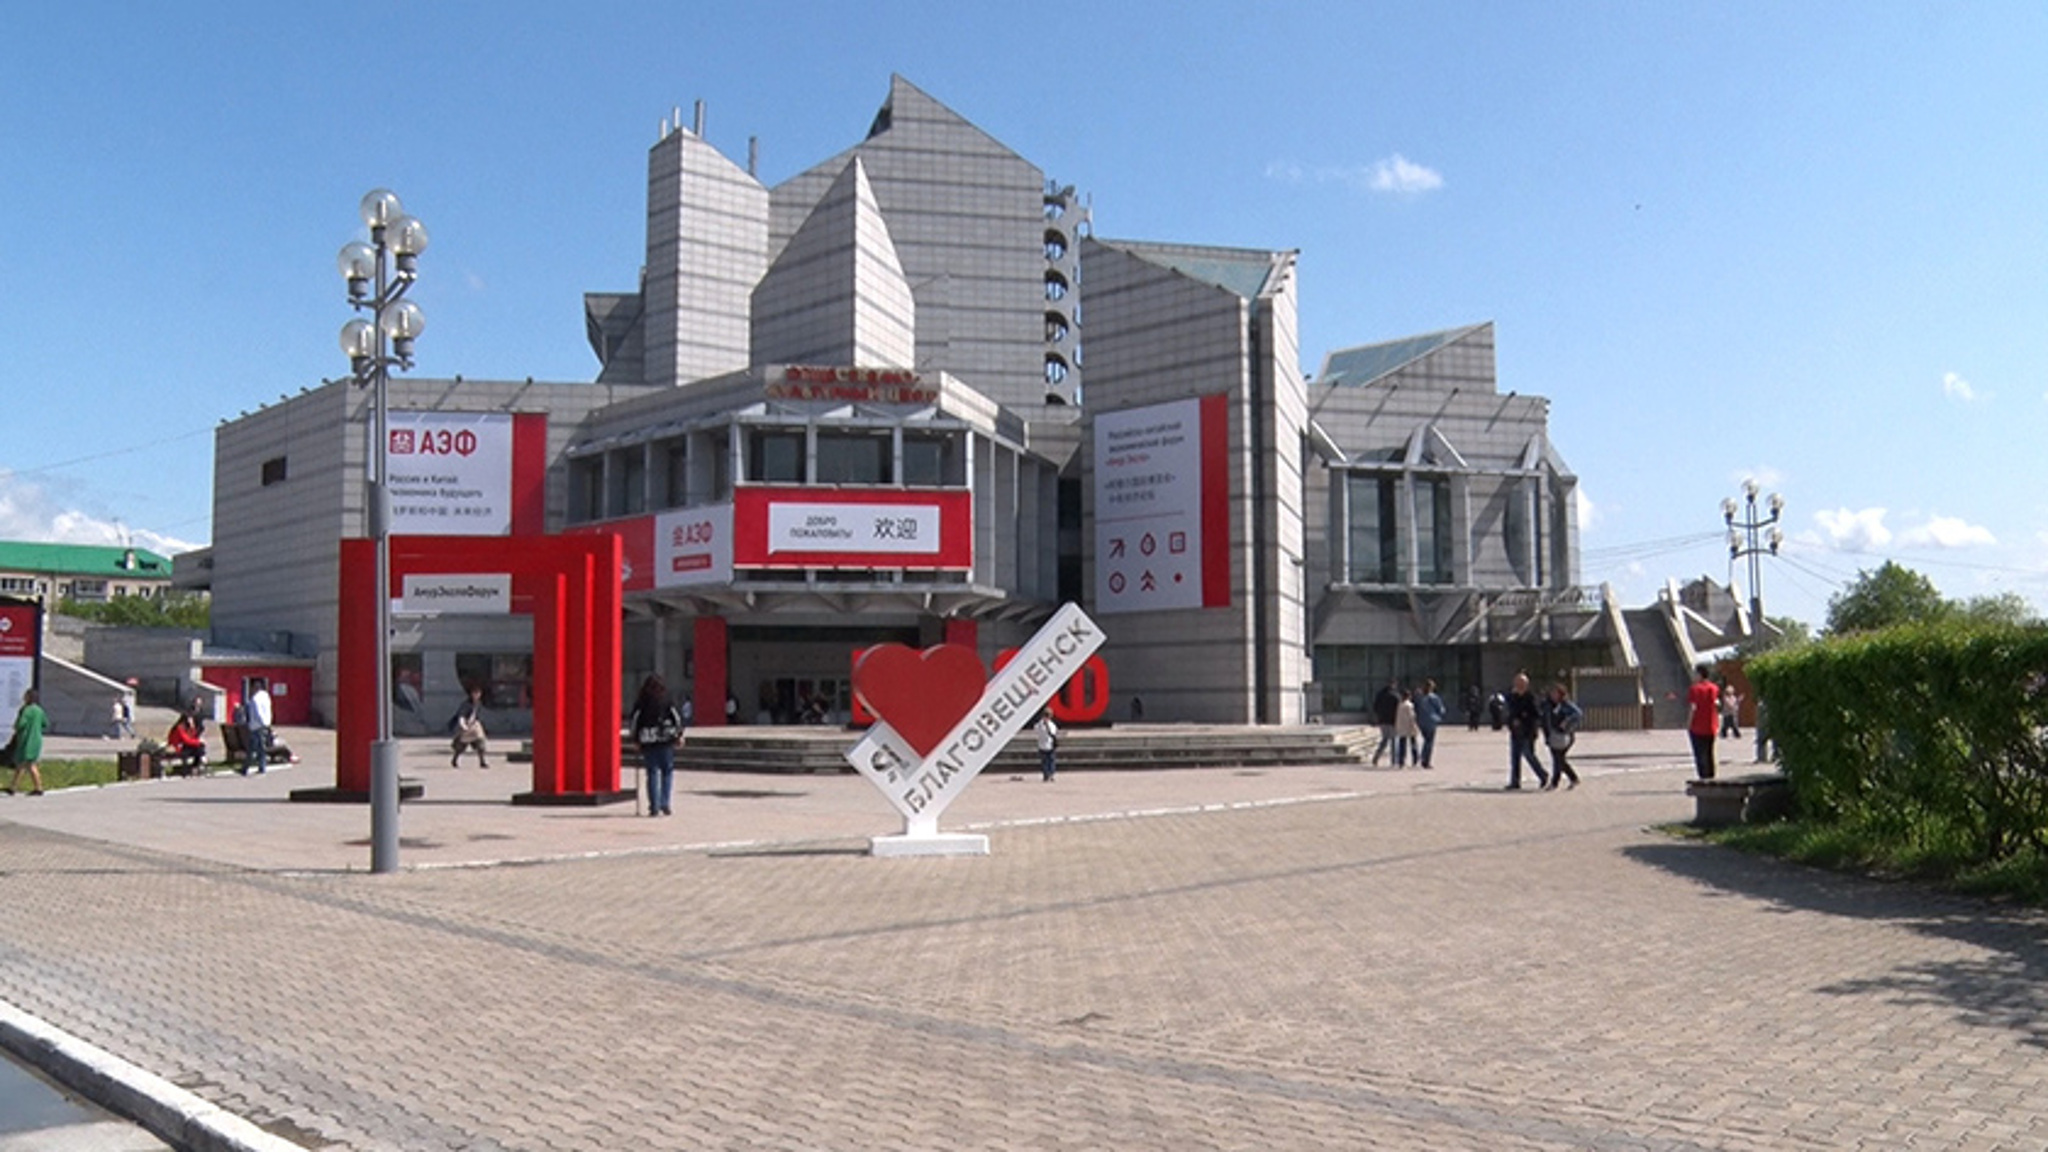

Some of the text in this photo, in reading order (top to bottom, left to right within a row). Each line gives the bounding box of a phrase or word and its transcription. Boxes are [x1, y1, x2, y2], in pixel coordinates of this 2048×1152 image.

[419, 428, 477, 457] АЭФ
[389, 473, 420, 484] Россия
[431, 473, 459, 484] Китай
[685, 521, 713, 545] АЭФ
[805, 515, 838, 527] ДОБРО
[873, 516, 918, 540] 欢迎
[902, 617, 1092, 814] БЛАГОВЕЩЕНСК
[870, 743, 908, 784] Я
